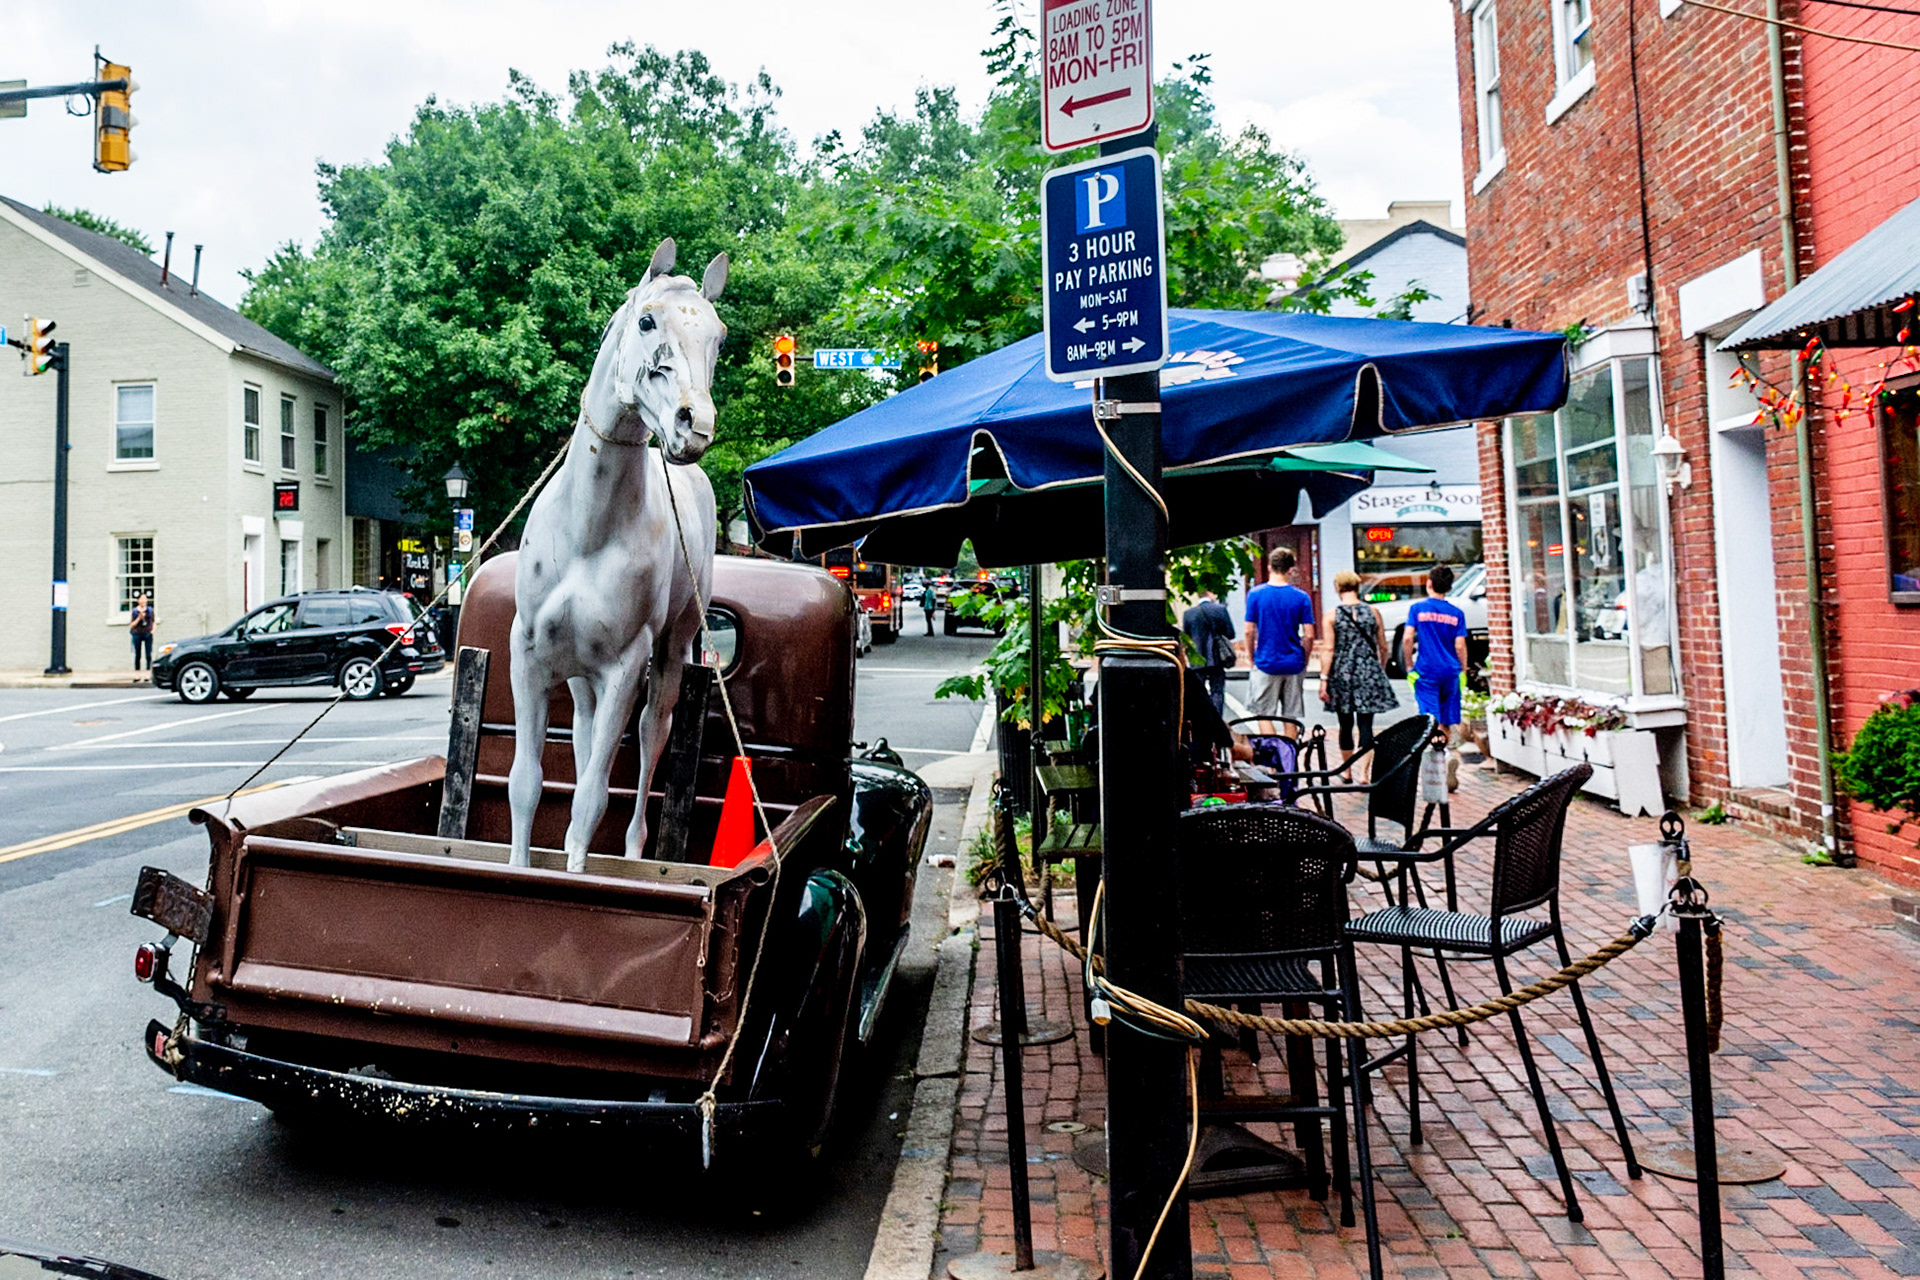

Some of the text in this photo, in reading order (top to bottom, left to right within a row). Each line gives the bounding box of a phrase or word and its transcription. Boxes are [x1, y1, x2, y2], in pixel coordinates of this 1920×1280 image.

[1053, 2, 1100, 34] LOADING
[1049, 12, 1143, 63] 8AM TO 5PM
[1049, 40, 1143, 89] MON-FRI
[1082, 173, 1120, 230] P
[1068, 230, 1136, 263] 3 HOUR
[1055, 256, 1153, 293] PAY PARKING
[1080, 287, 1128, 309] MON-SAT
[1102, 309, 1138, 330] 5-9PM
[819, 351, 855, 366] WEST
[1066, 339, 1116, 362] 8AM-9PM
[1358, 493, 1417, 511] Stage
[1368, 530, 1391, 541] OPEN
